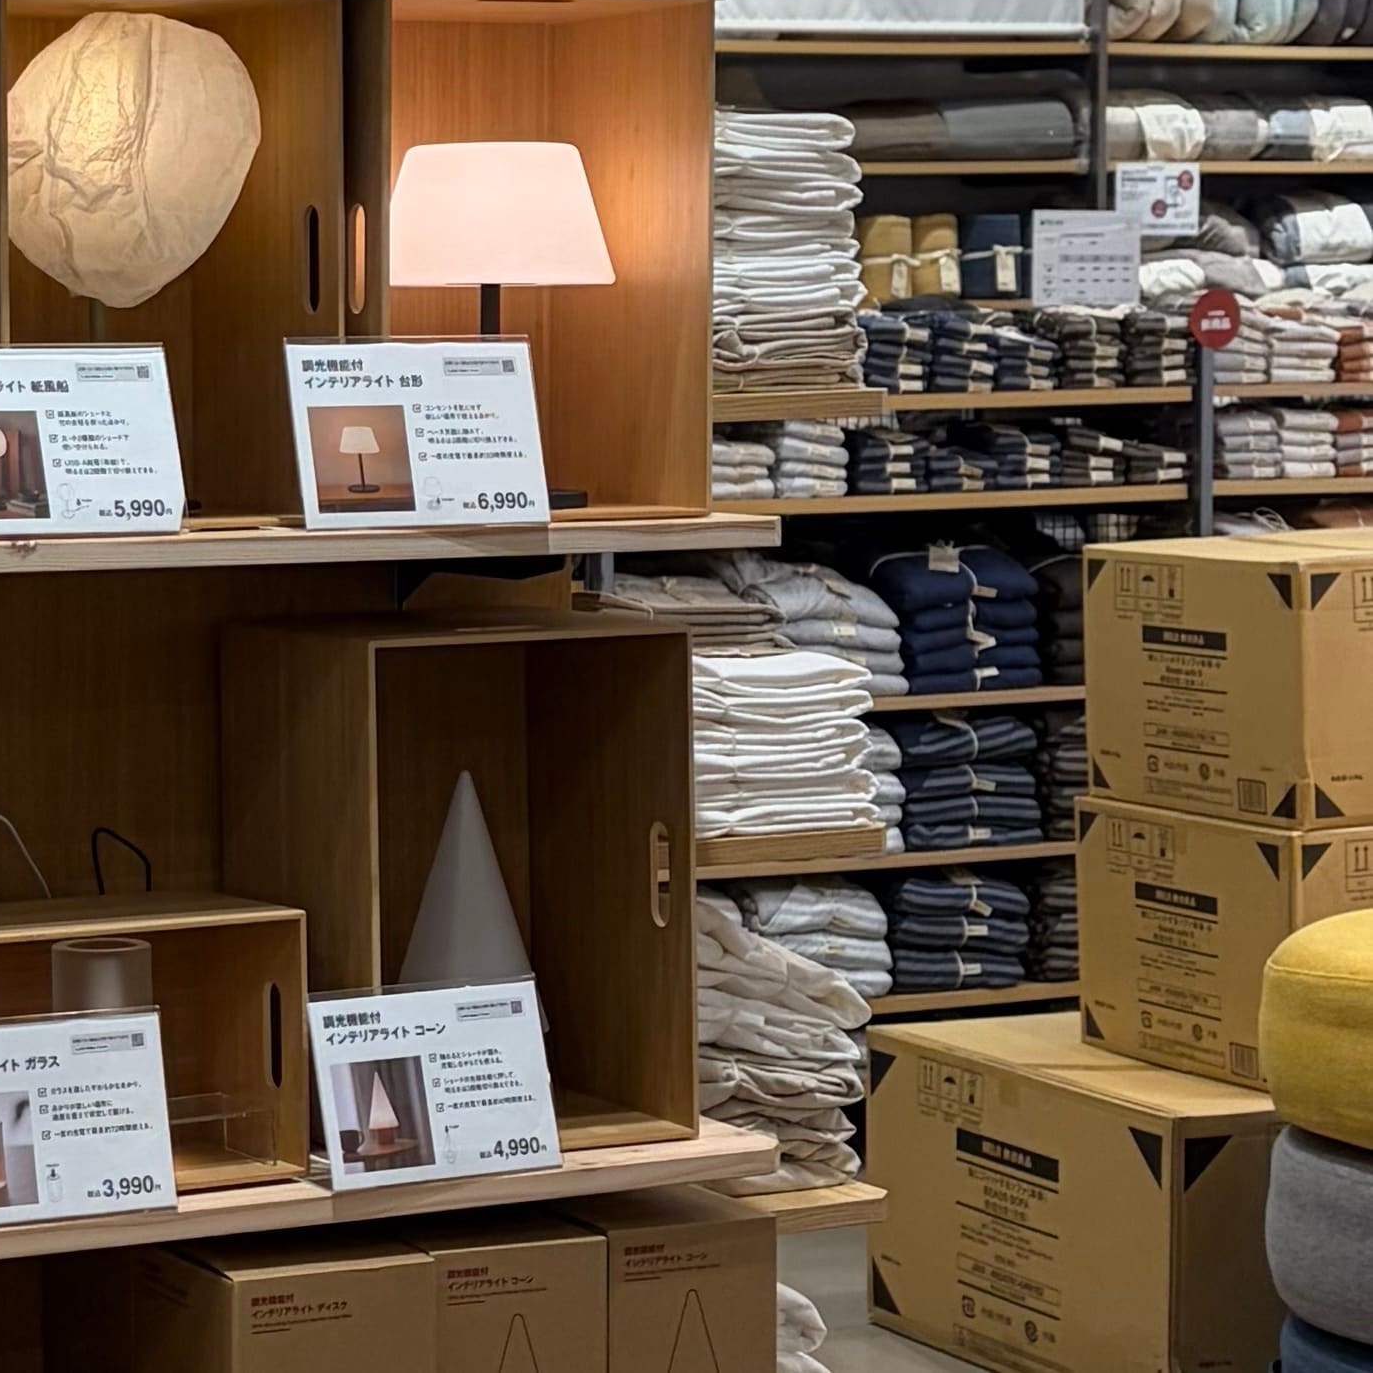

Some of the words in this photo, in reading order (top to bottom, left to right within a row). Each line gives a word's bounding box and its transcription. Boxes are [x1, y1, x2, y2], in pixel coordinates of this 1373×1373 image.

[301, 358, 364, 373] 調光機能付
[30, 380, 69, 393] 紙風船
[304, 375, 395, 389] インテリアライト
[399, 375, 424, 388] 台形
[323, 1011, 382, 1029] 調光機能付
[325, 1025, 411, 1046] インテリアライト
[414, 1022, 447, 1037] コーン
[24, 1054, 61, 1071] ガラス
[511, 1275, 534, 1285] コーン
